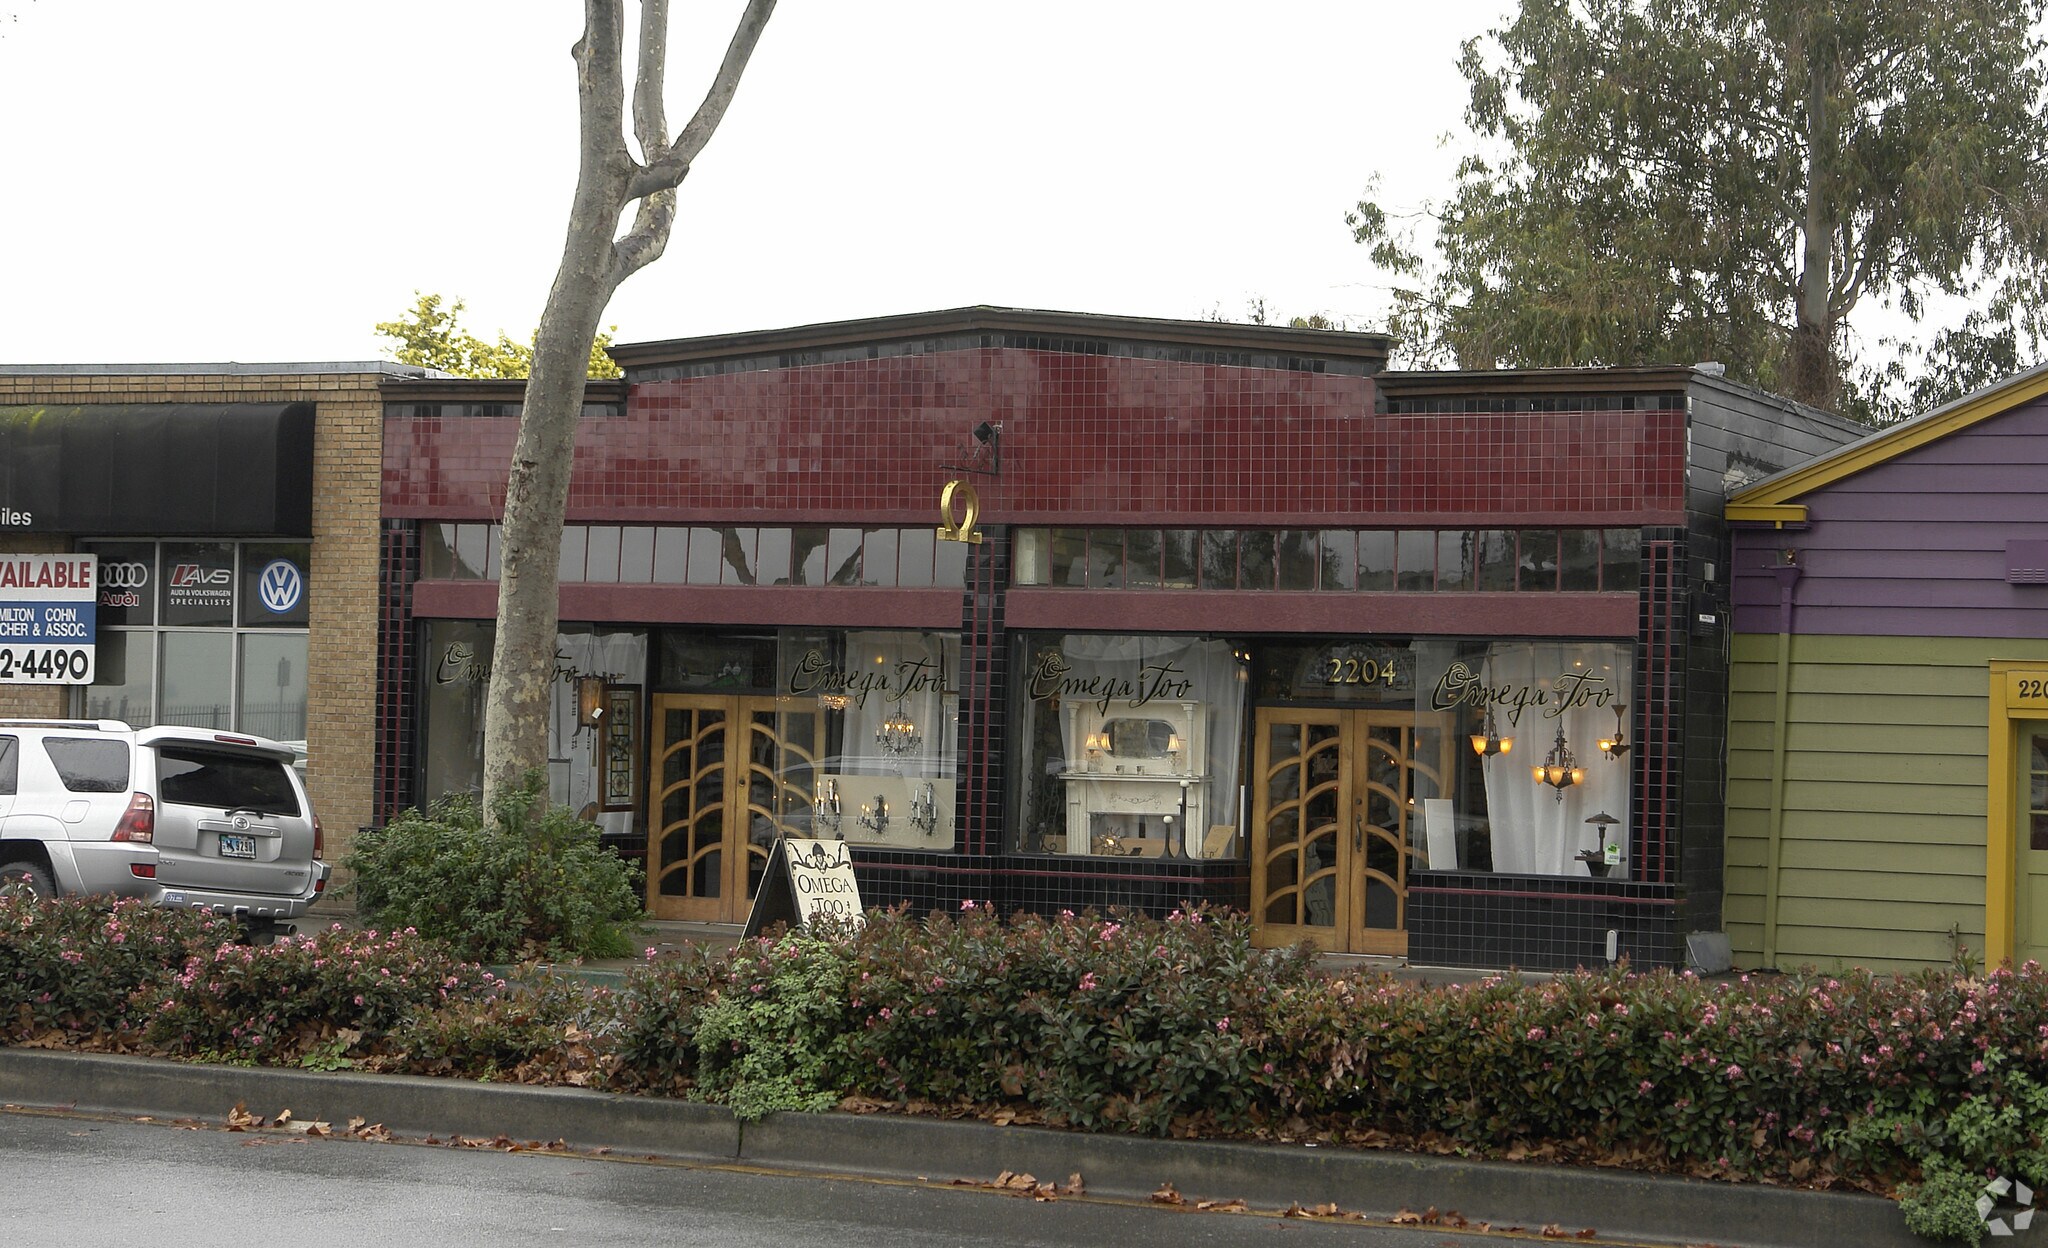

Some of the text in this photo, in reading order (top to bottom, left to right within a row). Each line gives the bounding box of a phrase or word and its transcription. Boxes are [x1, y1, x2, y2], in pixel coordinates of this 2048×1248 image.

[0, 561, 91, 588] AILABLE
[181, 569, 231, 584] AVS
[99, 591, 140, 607] Audi
[170, 589, 185, 597] AUDI
[186, 589, 191, 597] &
[45, 608, 77, 622] COHN
[32, 623, 41, 637] &
[45, 623, 88, 637] ASSOC.
[551, 648, 580, 683] oo
[1328, 658, 1397, 686] 2204
[789, 650, 947, 711] Omega Too
[1029, 654, 1193, 718] Omega Too
[1431, 662, 1615, 728] Omega Too
[798, 874, 854, 894] OMEGA
